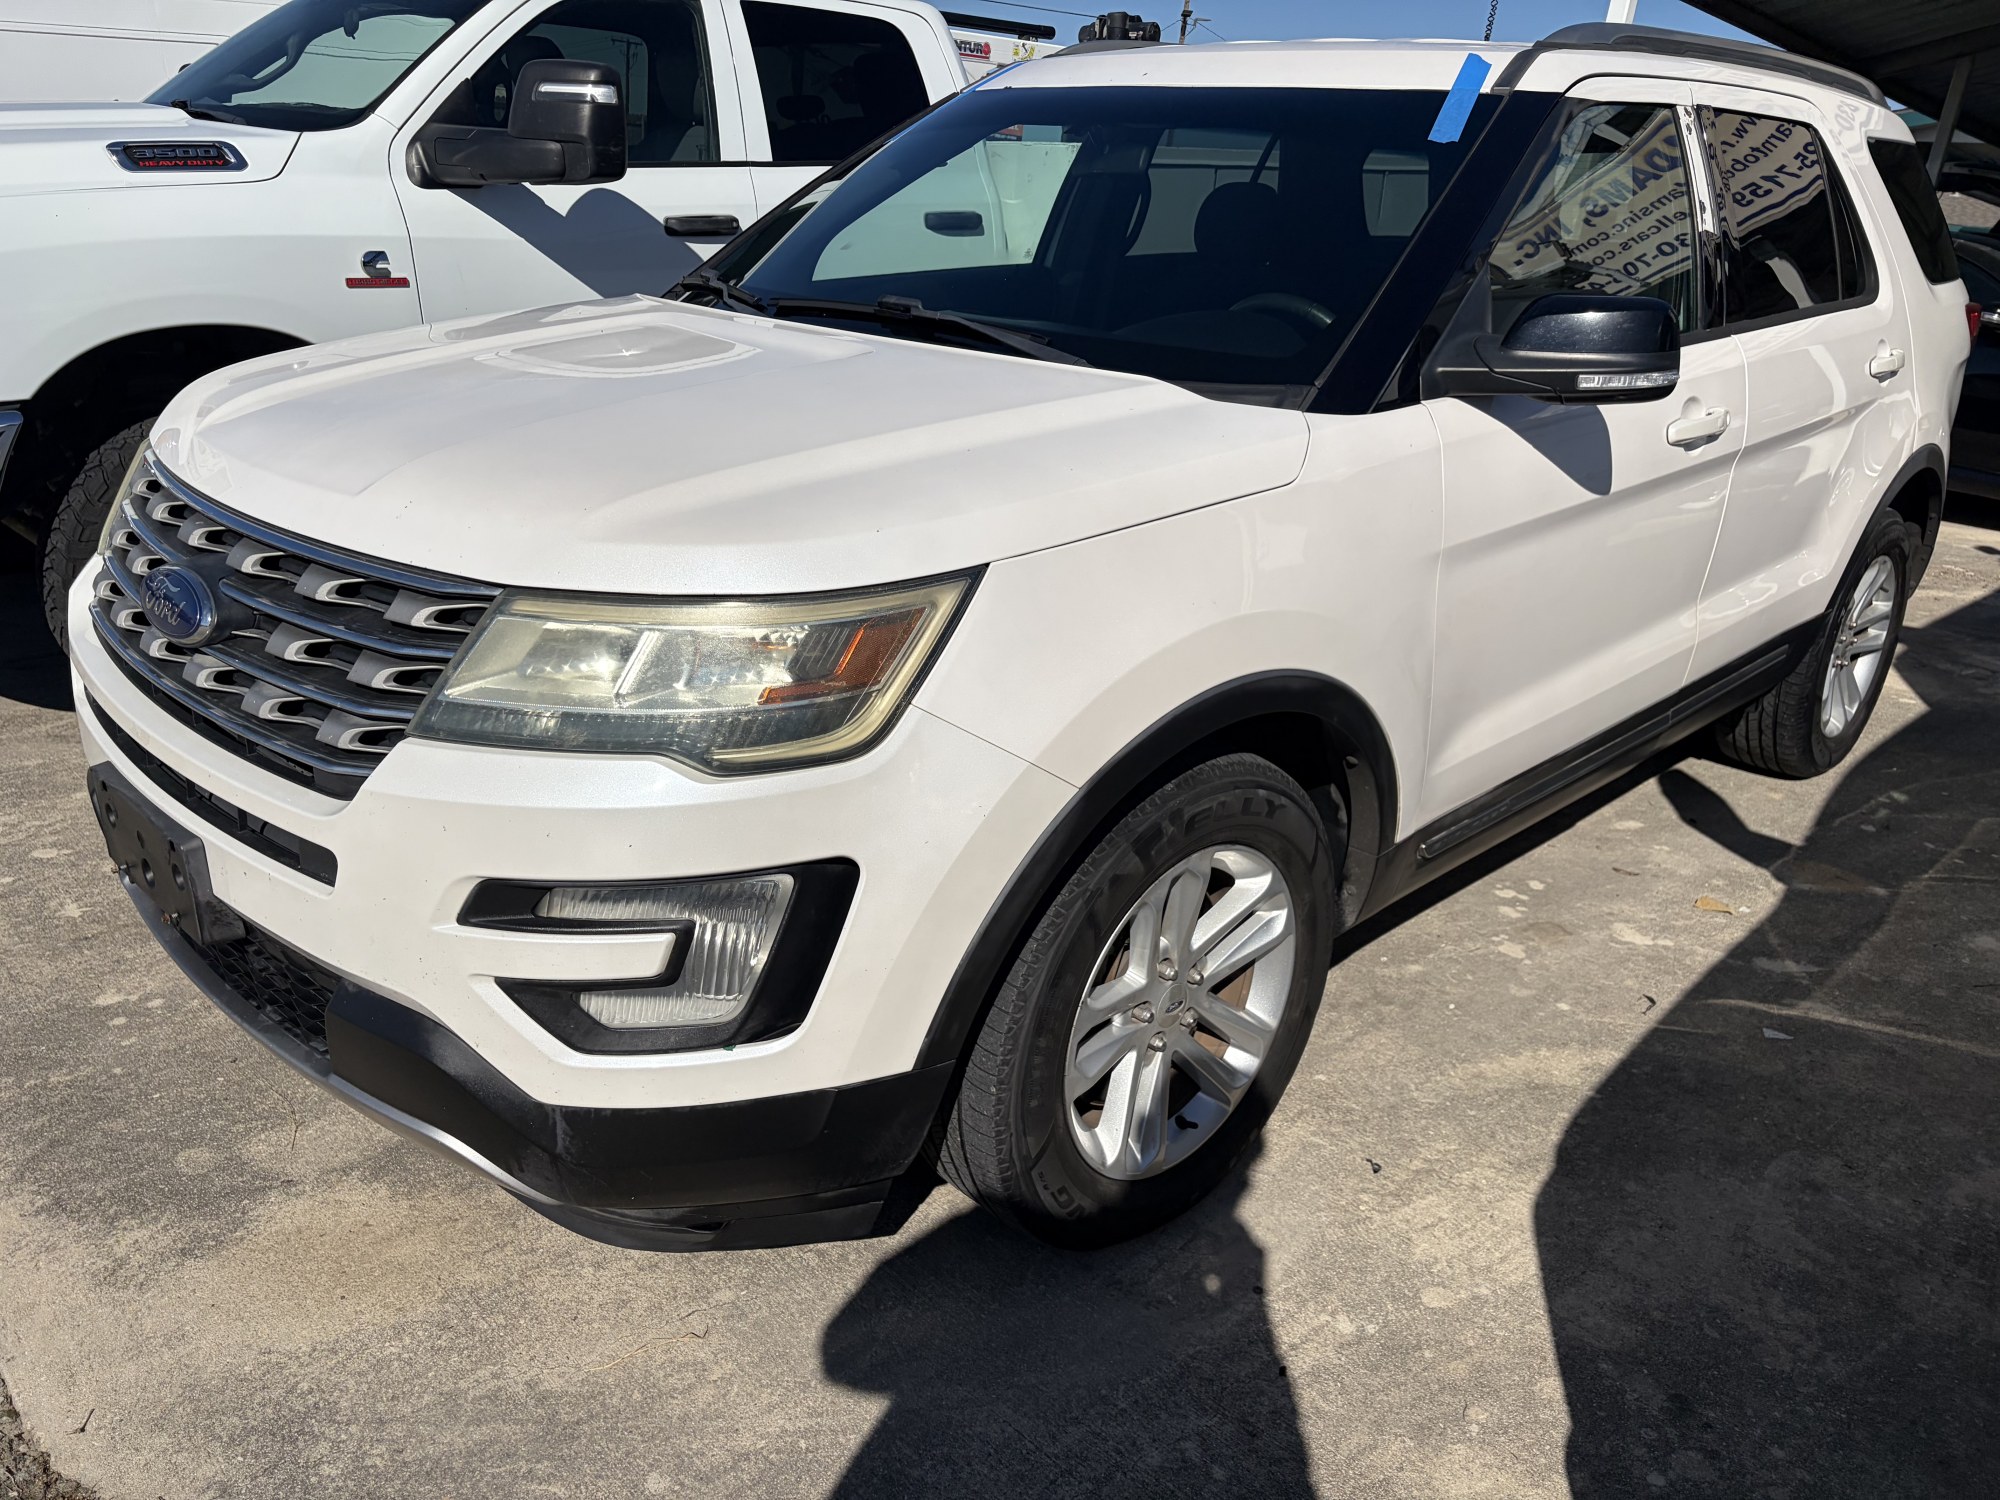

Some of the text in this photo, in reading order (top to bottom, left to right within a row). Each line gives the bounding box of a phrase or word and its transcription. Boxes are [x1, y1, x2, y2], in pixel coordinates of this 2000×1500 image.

[132, 147, 220, 159] 3500
[138, 159, 226, 168] HEAVY DUTY
[145, 578, 187, 626] Ford
